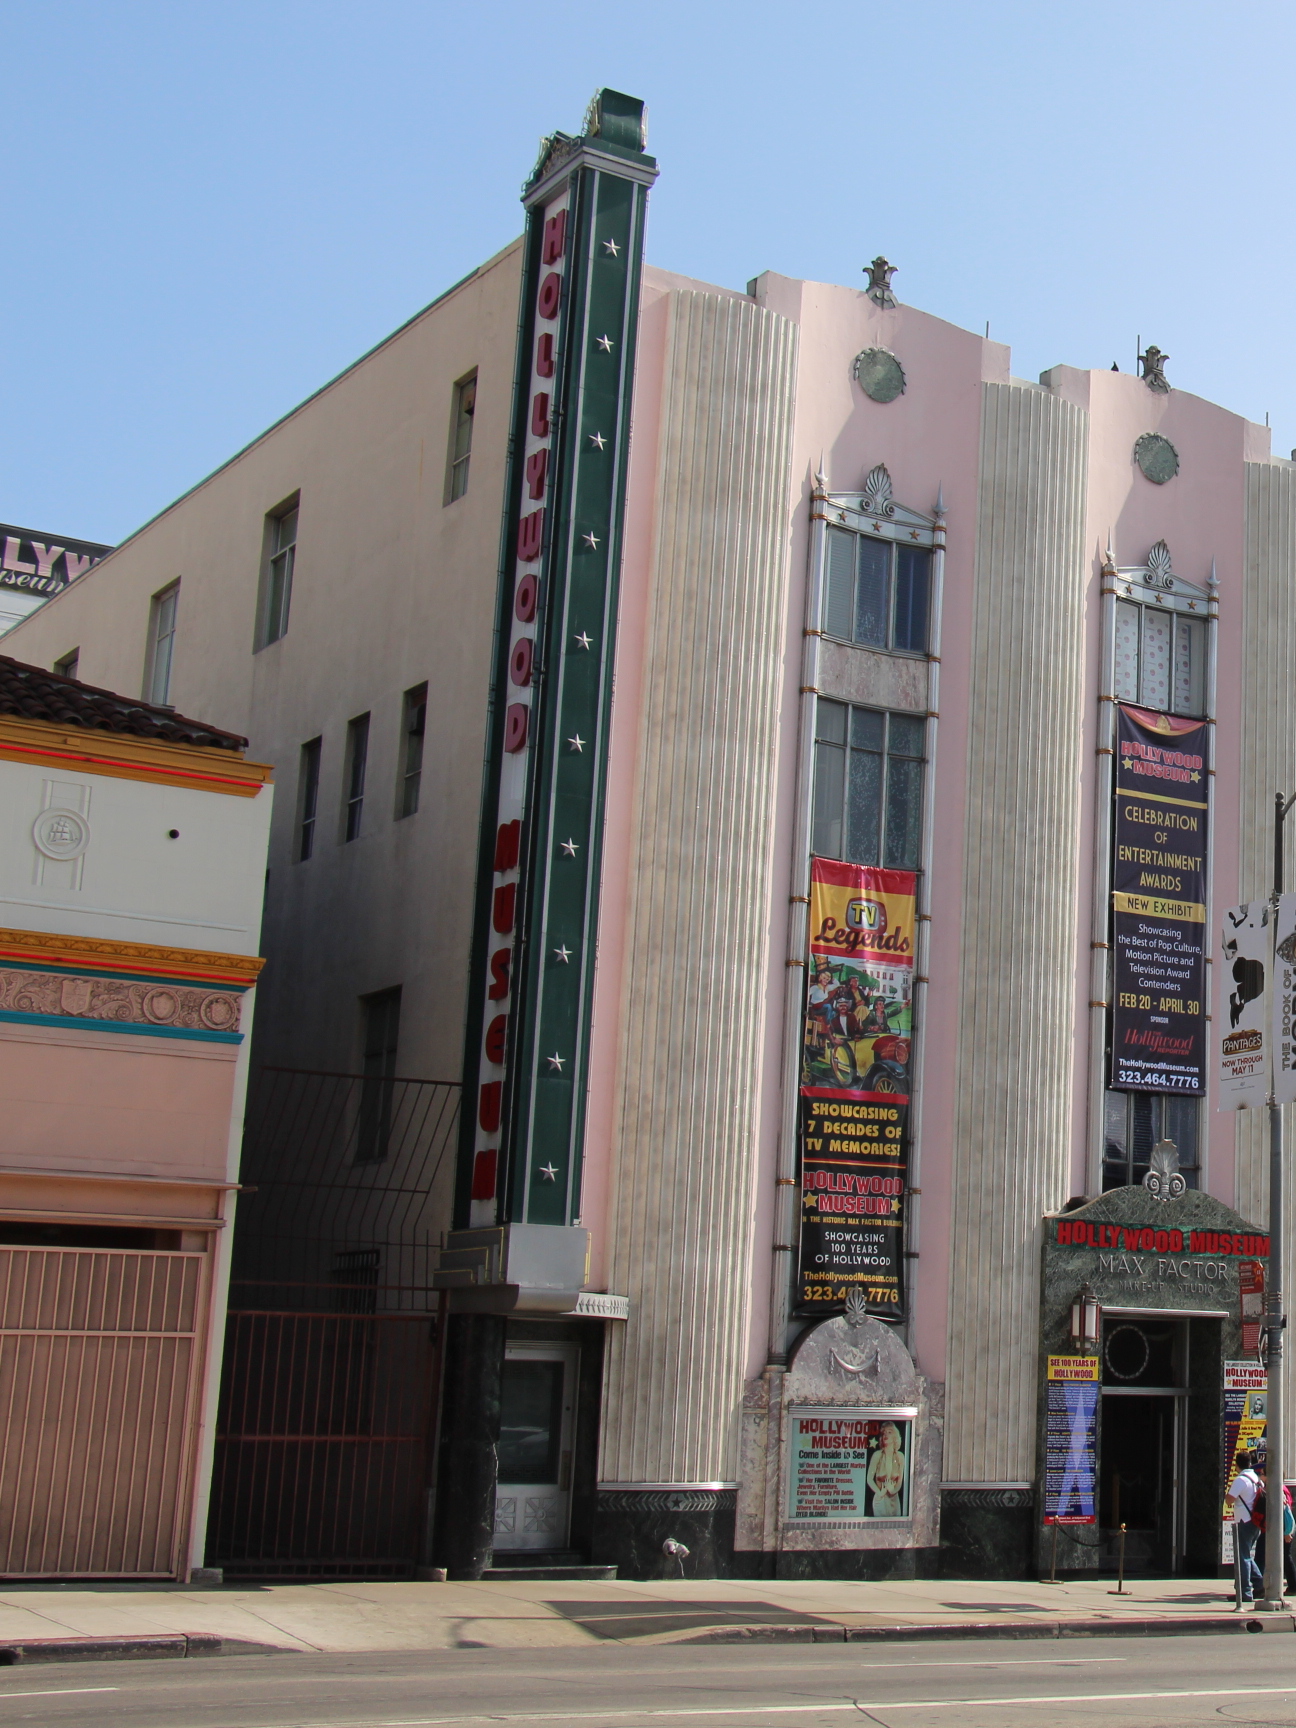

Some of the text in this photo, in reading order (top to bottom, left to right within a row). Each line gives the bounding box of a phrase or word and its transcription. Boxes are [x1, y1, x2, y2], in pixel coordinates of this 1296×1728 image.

[505, 208, 570, 755] HOLLYWOOD
[1121, 740, 1202, 769] HOLLYWOOD
[1133, 759, 1190, 783] MUSEUM
[1125, 805, 1198, 832] CELEBRATION
[1154, 831, 1168, 844] OF
[1118, 845, 1202, 872] ENTERTAINMENT
[1139, 871, 1182, 891] AWARDS
[851, 903, 877, 926] TV
[1127, 897, 1193, 917] NEW EXHIBIT
[814, 917, 909, 954] Legends
[1138, 924, 1182, 940] Showcasing
[1118, 934, 1202, 955] the Best of Pop Culture,
[1125, 949, 1194, 966] Motion Picture and
[1129, 963, 1190, 979] Television Award
[1138, 978, 1181, 991] Contenders
[1120, 992, 1199, 1015] FEB 20 APRIL 30
[1282, 969, 1292, 1071] THE BOOK OF
[1124, 1028, 1194, 1052] Hollywood
[1223, 1034, 1262, 1052] PANTAGES
[1157, 1047, 1190, 1056] REPORTER
[1119, 1058, 1199, 1073] TheHollywoodMuseum.com
[1222, 1054, 1263, 1068] NOW THROUGH
[1232, 1064, 1254, 1076] MAY 11
[1118, 1070, 1199, 1089] 323.464.7776
[812, 1102, 898, 1121] SHOWCASING
[807, 1120, 902, 1139] 7 DECADES OF
[806, 1138, 900, 1156] TV MEMORIES!
[803, 1170, 903, 1195] HOLLYWOOD
[818, 1194, 890, 1215] MUSEUM
[822, 1217, 846, 1225] HISTORIC
[824, 1231, 885, 1243] SHOWCASING
[1057, 1220, 1271, 1257] HOLLYWOOD MUSEUM
[831, 1243, 878, 1254] 100 YEARS
[815, 1254, 891, 1266] OF HOLLYWOOD
[1099, 1254, 1144, 1275] MAX
[1158, 1258, 1229, 1280] FACTOR
[804, 1271, 898, 1283] TheHollywoodMuseum.com
[804, 1286, 899, 1303] 323.4.7776
[1178, 1284, 1215, 1294] STUDIO
[1050, 1359, 1060, 1367] SEE
[1061, 1359, 1072, 1367] 100
[1072, 1359, 1089, 1367] YEARS
[1054, 1369, 1094, 1379] HOLLYWOOD
[1225, 1368, 1268, 1378] HOLLYWOOD
[1232, 1378, 1263, 1388] MUSEUM
[799, 1419, 880, 1436] HOLLYWOOD
[812, 1436, 868, 1449] MUSEUM
[799, 1450, 819, 1459] Come
[821, 1450, 841, 1459] Inside
[852, 1451, 865, 1459] See
